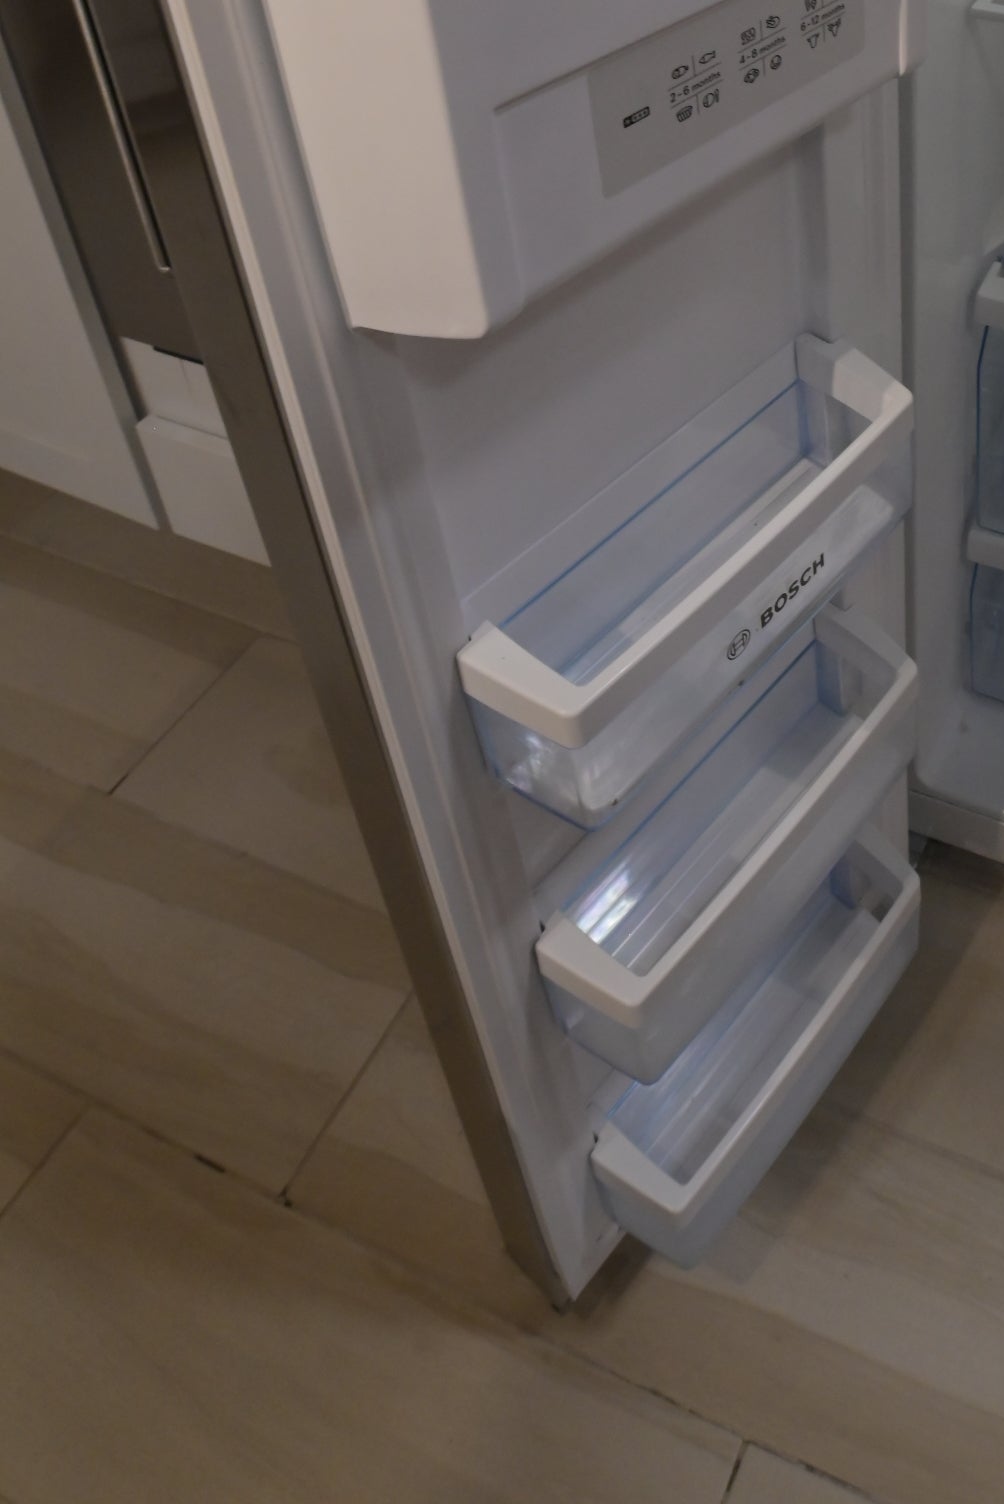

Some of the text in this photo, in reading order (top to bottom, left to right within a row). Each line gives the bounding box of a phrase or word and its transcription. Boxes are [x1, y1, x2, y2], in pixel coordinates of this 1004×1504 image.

[821, 3, 845, 20] months
[759, 35, 786, 54] months
[692, 71, 721, 92] months
[760, 553, 825, 628] BOSCH
